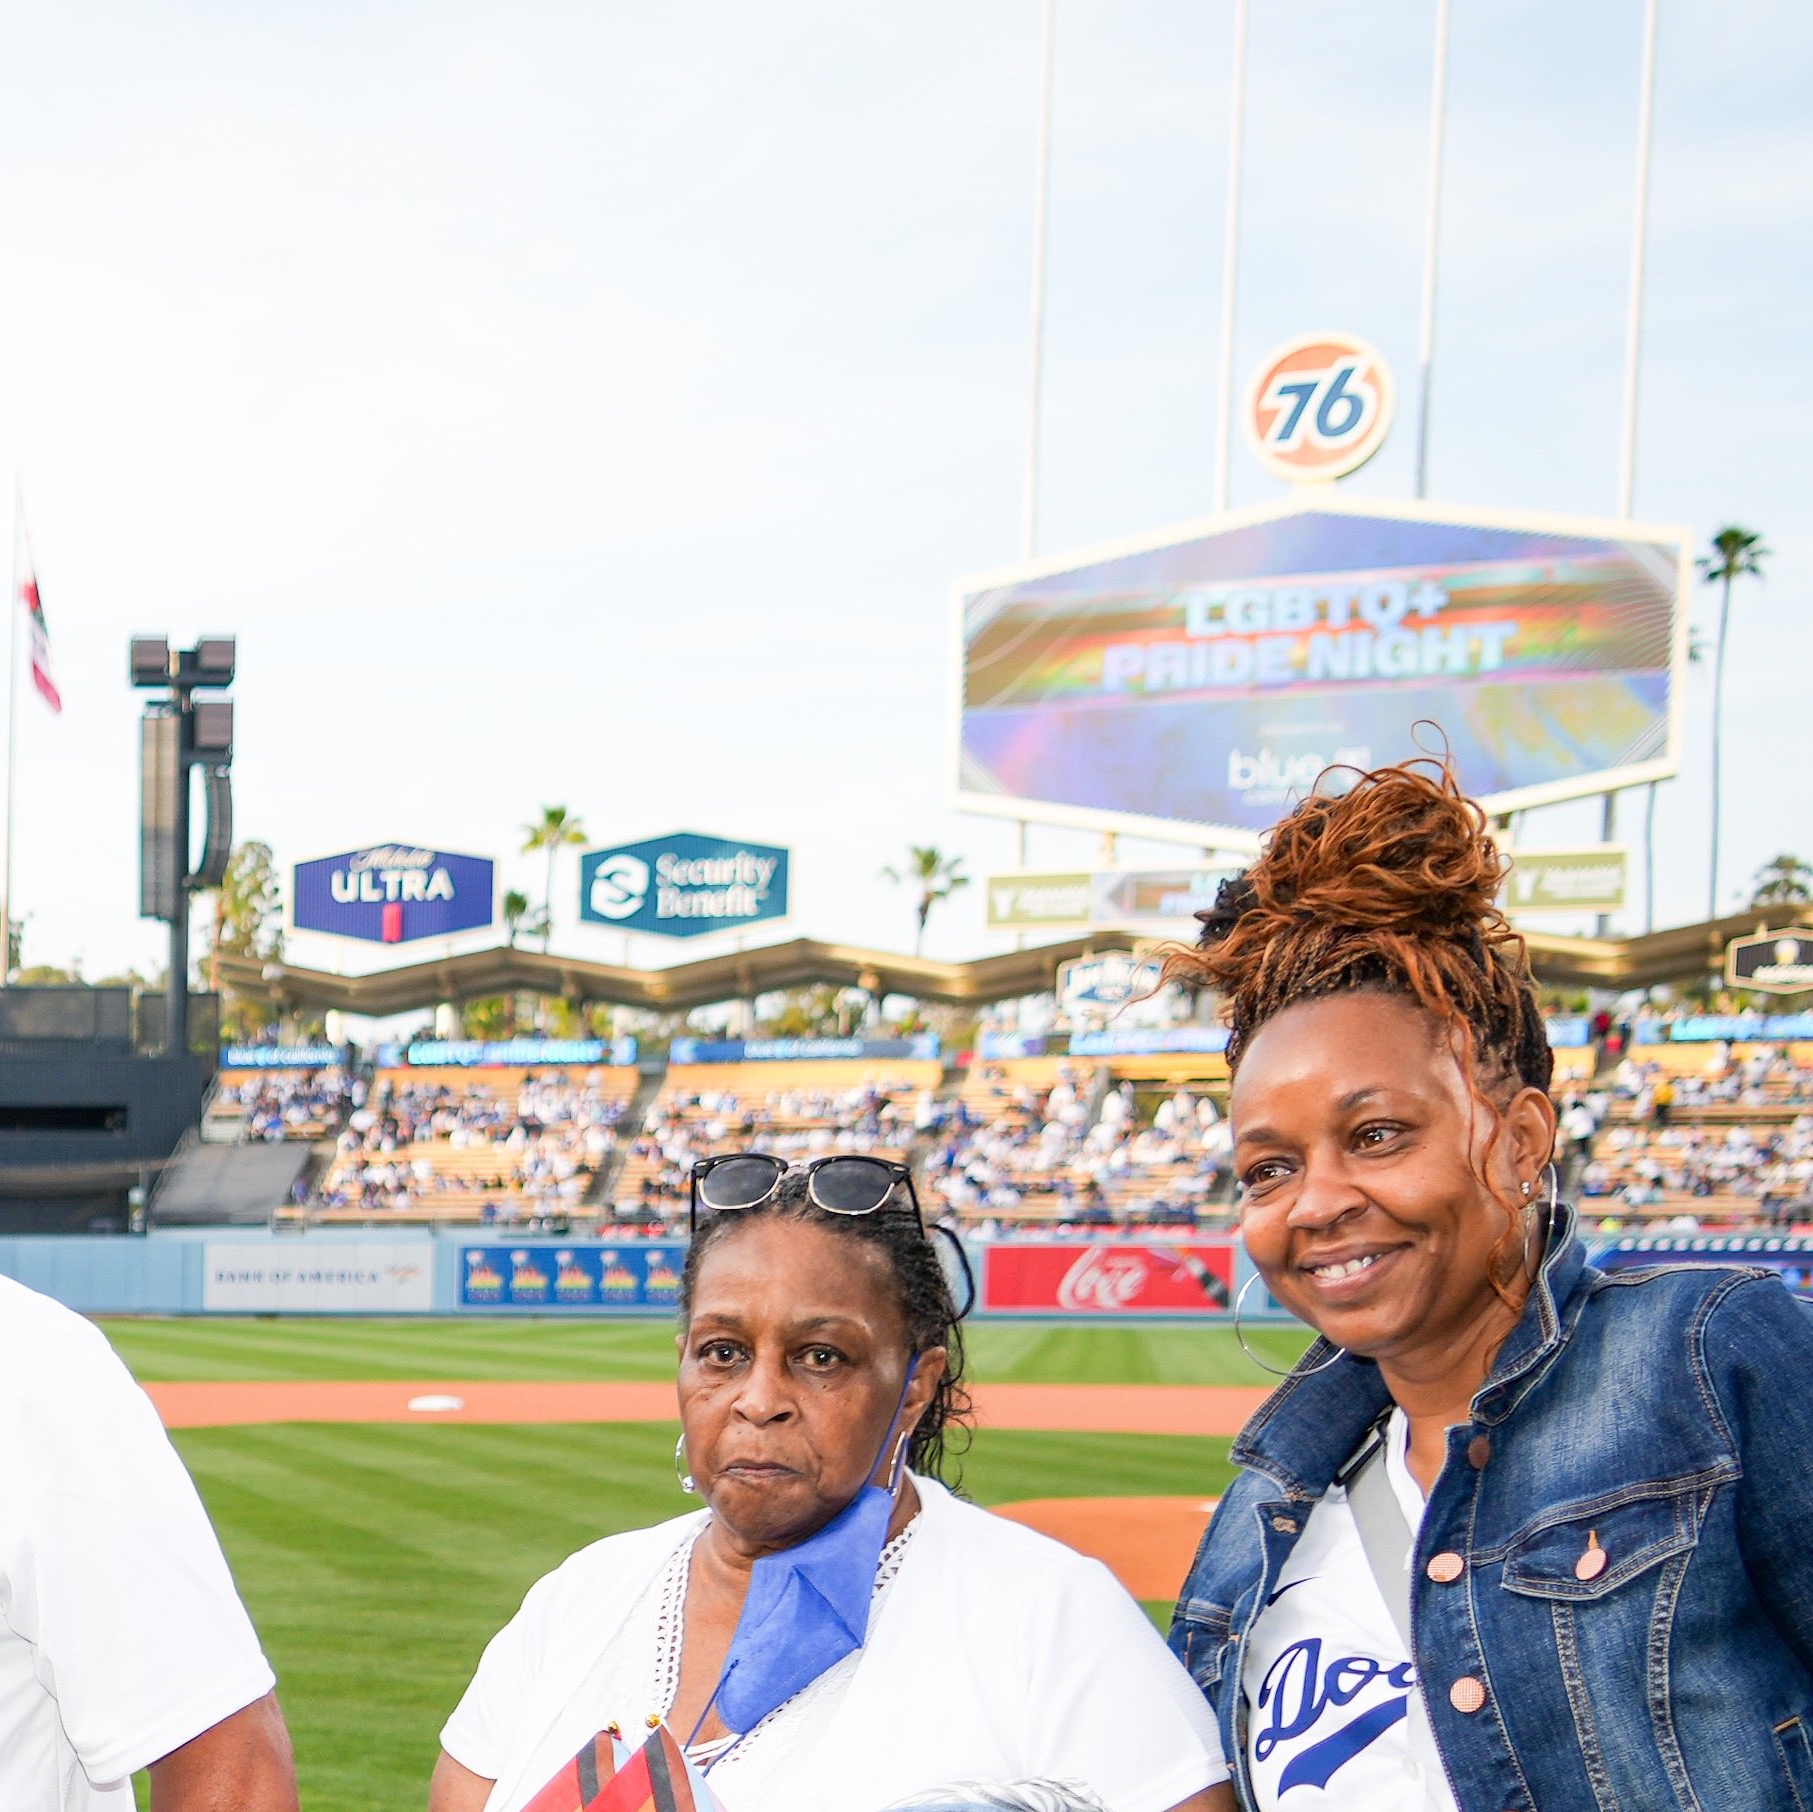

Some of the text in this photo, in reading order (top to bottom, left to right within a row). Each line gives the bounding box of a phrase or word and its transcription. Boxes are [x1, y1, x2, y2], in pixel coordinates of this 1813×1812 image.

[1270, 364, 1368, 441] 76
[1185, 580, 1450, 640] LGBTQ+
[1102, 620, 1519, 694] PRIDE NIGHT
[1228, 747, 1324, 790] blue
[331, 867, 455, 902] ULTRA
[656, 850, 777, 890] Security
[657, 883, 759, 918] Benefit
[215, 1268, 262, 1285] BANK
[297, 1268, 379, 1285] AMERICA
